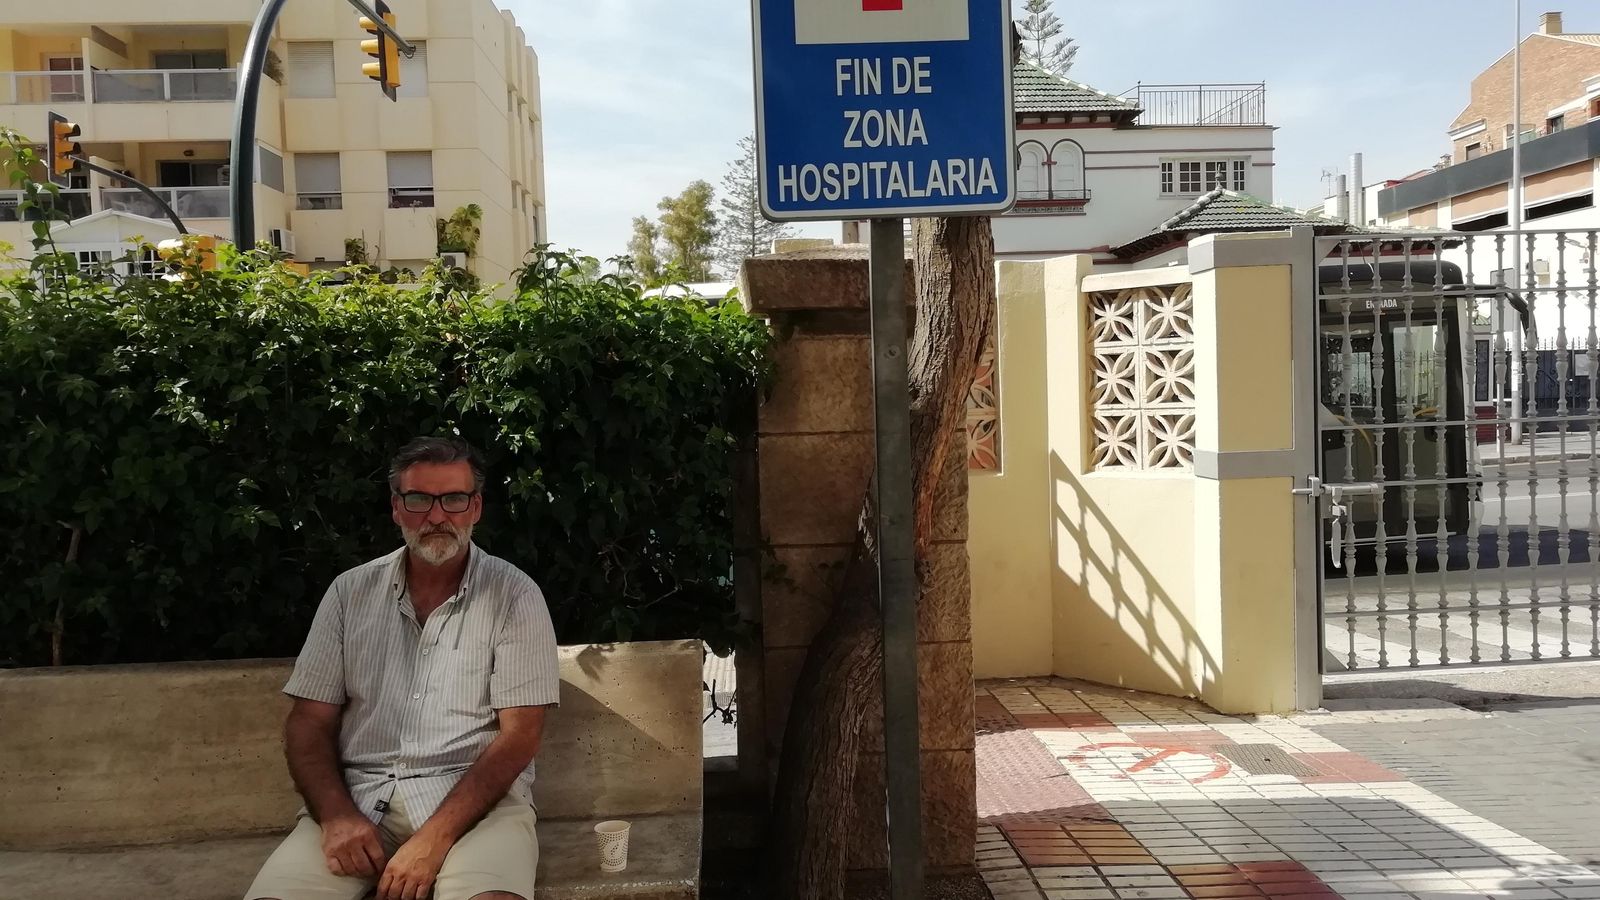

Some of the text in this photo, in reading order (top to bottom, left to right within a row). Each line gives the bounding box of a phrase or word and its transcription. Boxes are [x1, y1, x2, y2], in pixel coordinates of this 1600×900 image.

[836, 56, 932, 96] FIN DE
[843, 108, 929, 148] ZONA
[778, 157, 998, 202] HOSPITALARIA
[1365, 299, 1398, 309] ENADA
